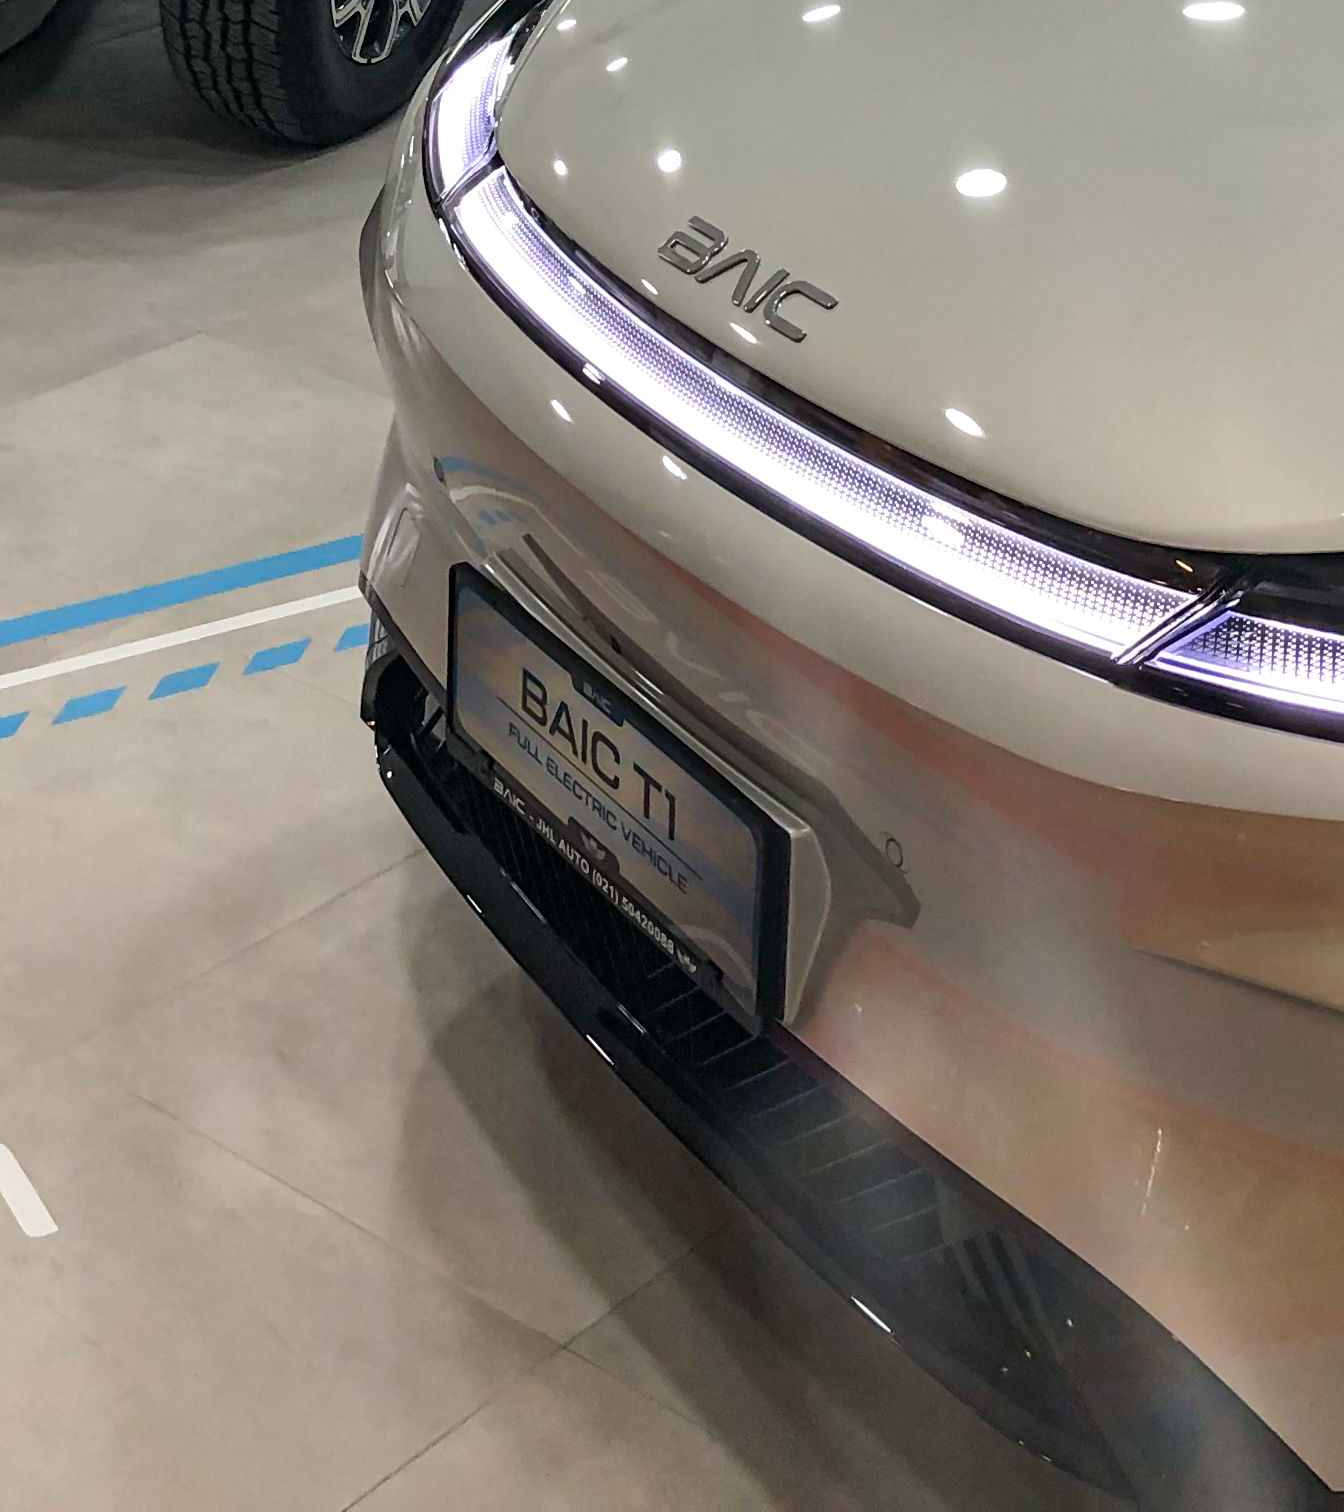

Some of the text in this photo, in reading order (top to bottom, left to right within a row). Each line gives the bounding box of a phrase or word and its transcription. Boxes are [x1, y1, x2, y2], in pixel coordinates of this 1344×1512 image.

[657, 215, 839, 343] BAIC
[508, 721, 689, 896] FULL ELECTRIC VEHICLE
[521, 668, 677, 841] BAIC T1
[494, 776, 527, 816] BAIC
[536, 817, 557, 842] JHL
[558, 838, 590, 875] AUTO
[591, 868, 619, 906] (021)
